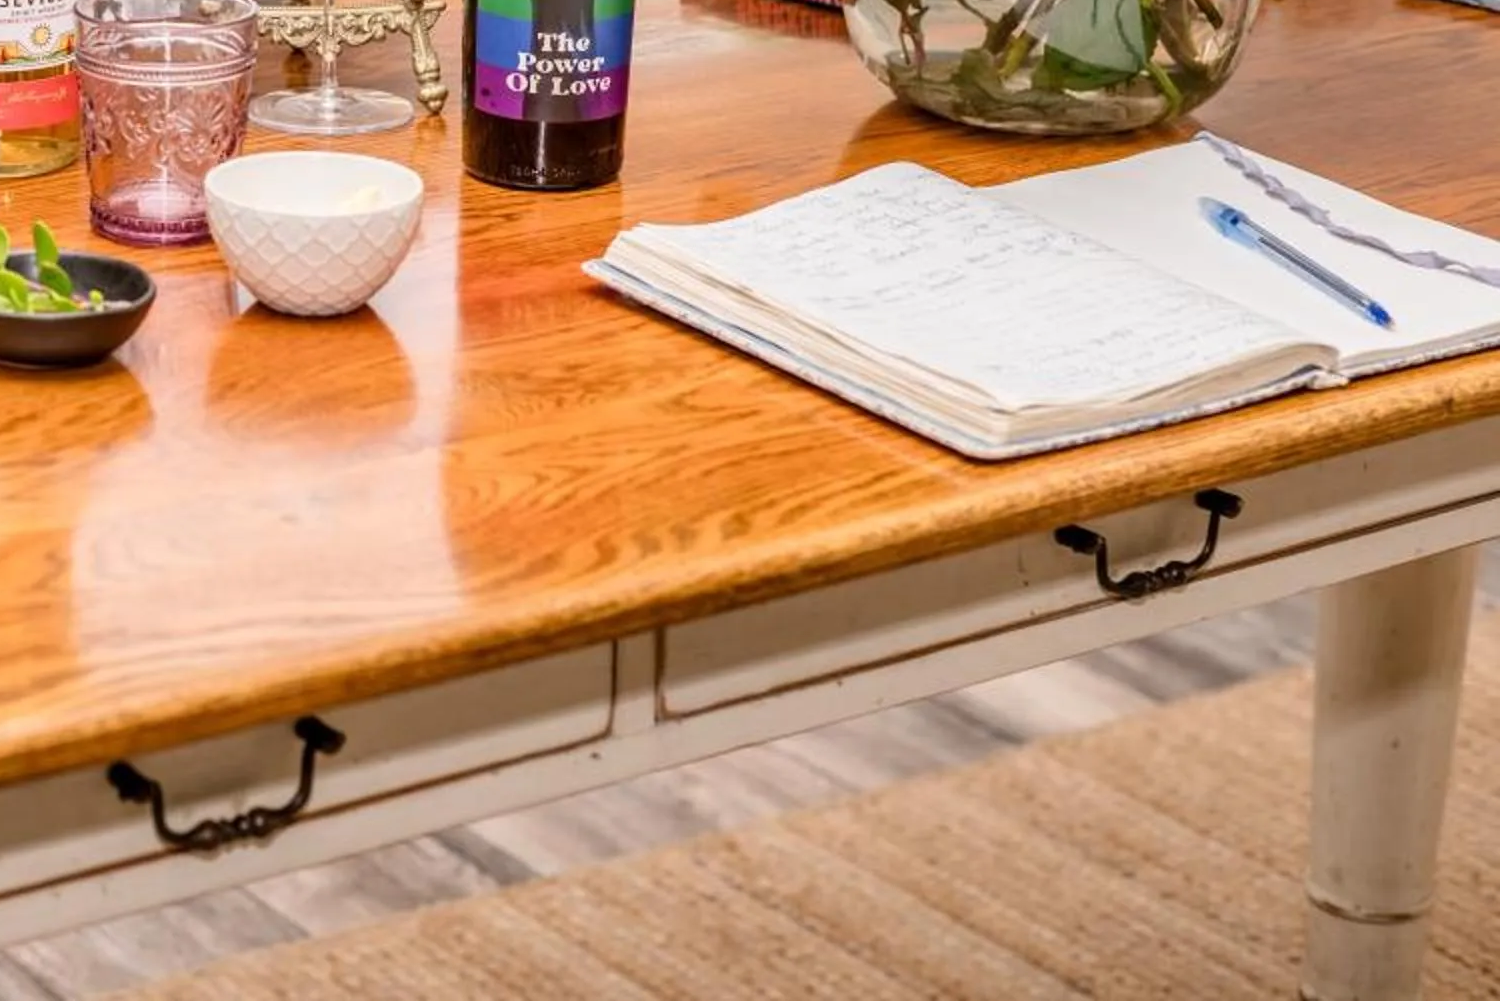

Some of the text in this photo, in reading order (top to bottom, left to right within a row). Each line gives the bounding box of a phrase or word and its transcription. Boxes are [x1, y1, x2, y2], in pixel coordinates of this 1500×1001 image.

[537, 31, 591, 53] The
[516, 51, 606, 74] Power
[505, 72, 612, 96] Of Love
